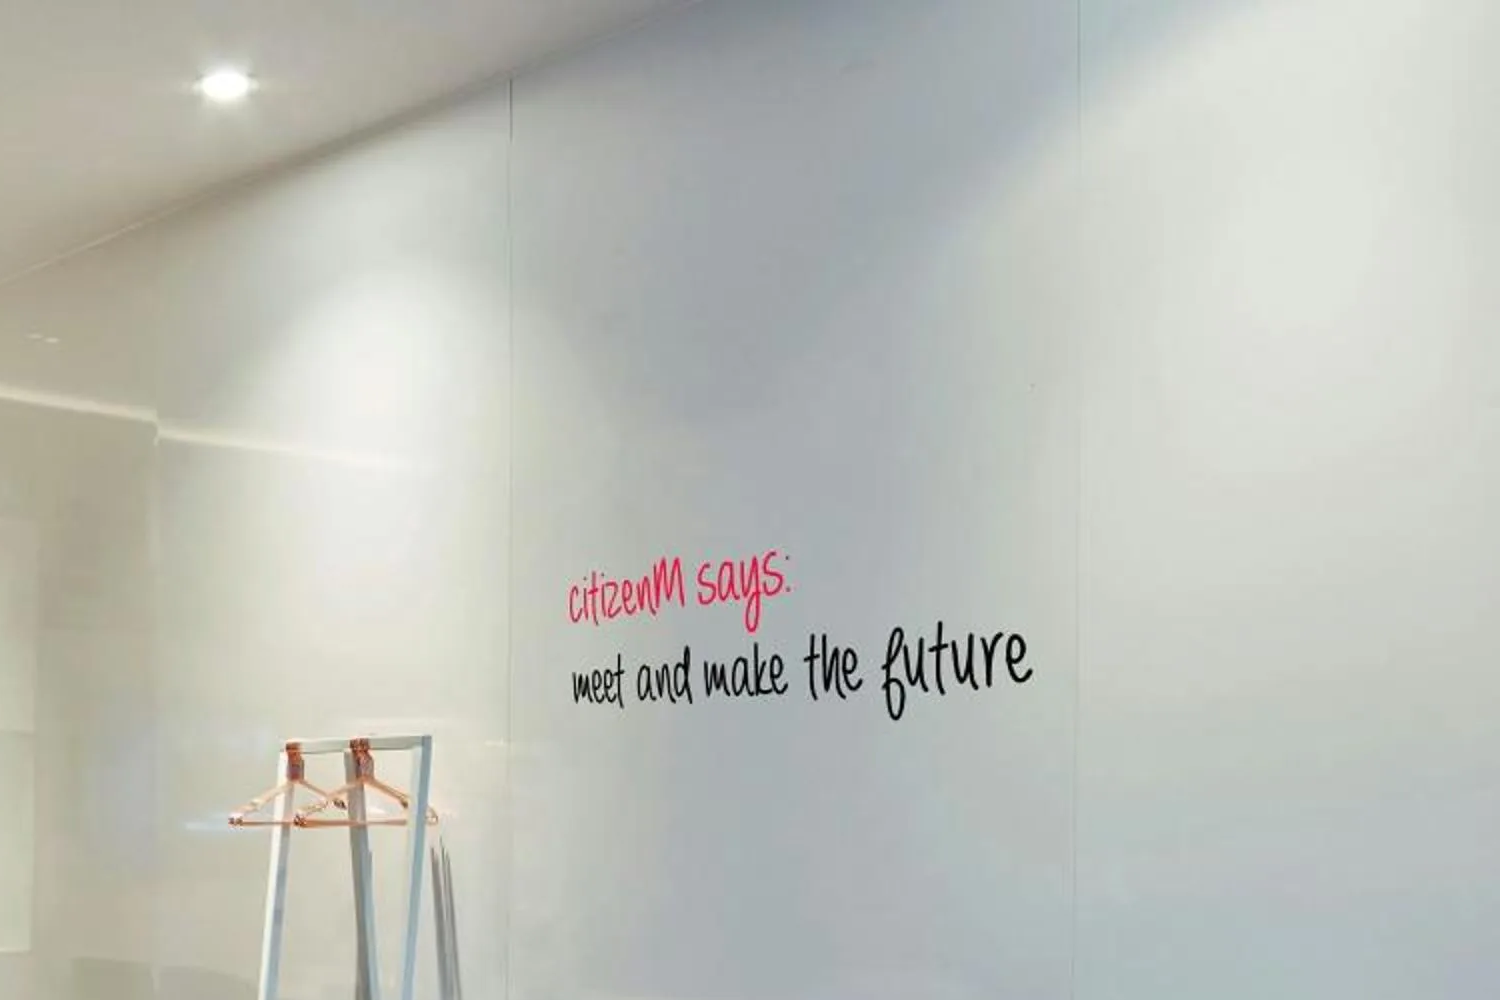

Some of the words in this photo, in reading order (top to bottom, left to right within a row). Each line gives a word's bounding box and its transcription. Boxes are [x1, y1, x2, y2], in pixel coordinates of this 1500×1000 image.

[568, 557, 686, 625] citizenM
[696, 550, 790, 633] says:
[573, 654, 624, 708] meet
[637, 646, 692, 704] and
[704, 643, 788, 696] make
[804, 634, 863, 700] the
[882, 621, 1033, 720] future
